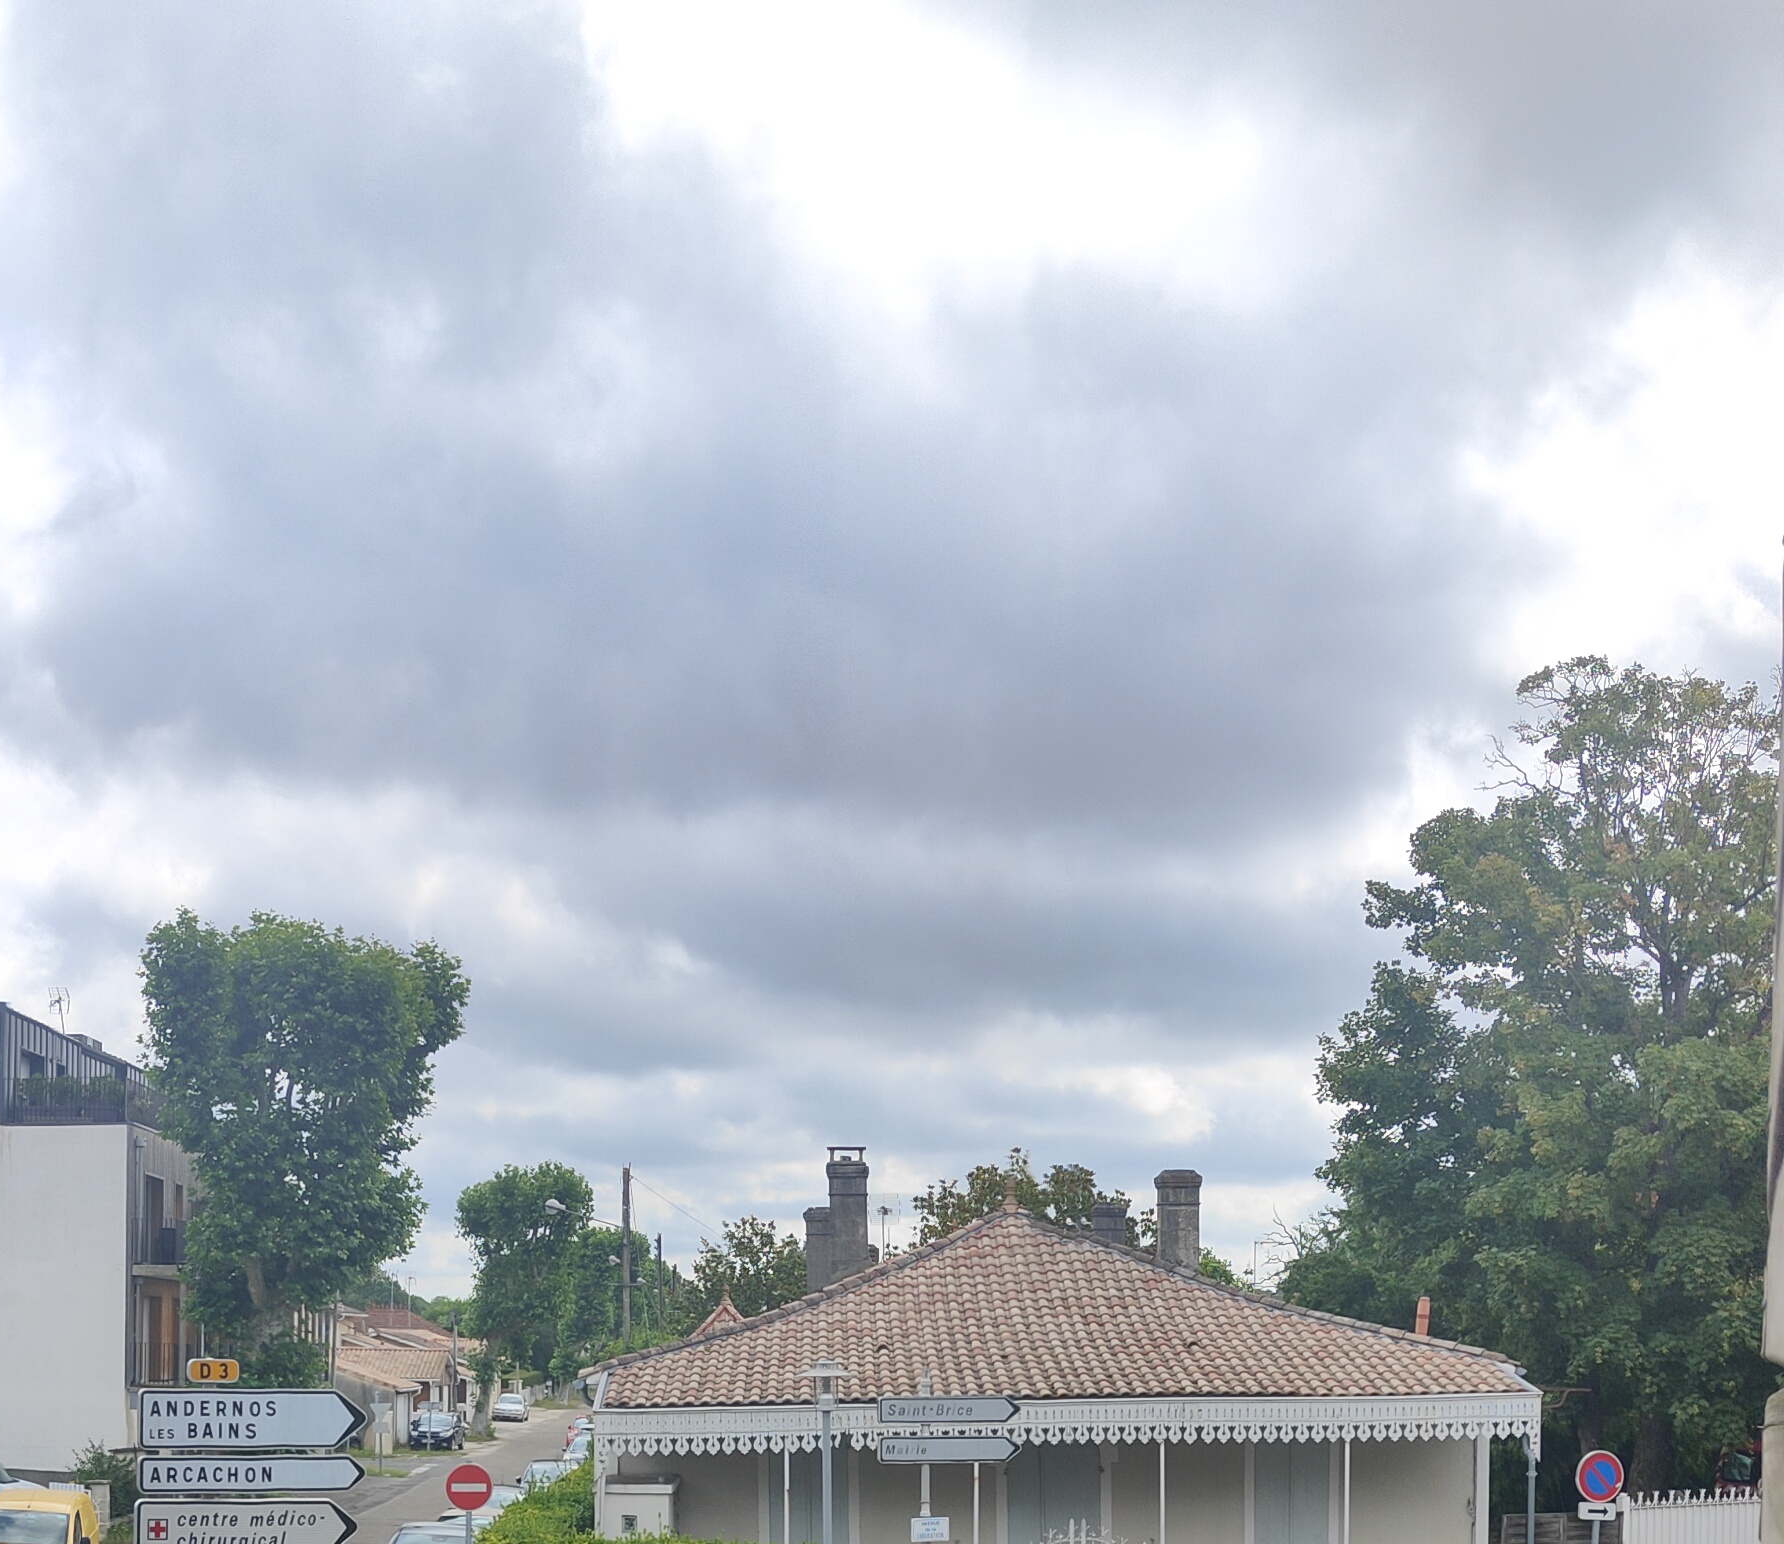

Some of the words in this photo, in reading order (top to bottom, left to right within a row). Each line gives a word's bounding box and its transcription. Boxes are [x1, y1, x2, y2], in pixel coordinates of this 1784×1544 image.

[200, 1362, 211, 1379] D
[219, 1363, 229, 1379] 3
[149, 1400, 277, 1417] ANDERNOS
[888, 1404, 973, 1417] Saint-Brice
[149, 1428, 175, 1440] LES
[187, 1422, 257, 1439] BAINS
[885, 1444, 927, 1455] Mairie
[150, 1466, 273, 1483] ARCACHON
[177, 1512, 238, 1527] centre
[250, 1510, 325, 1526] médico-
